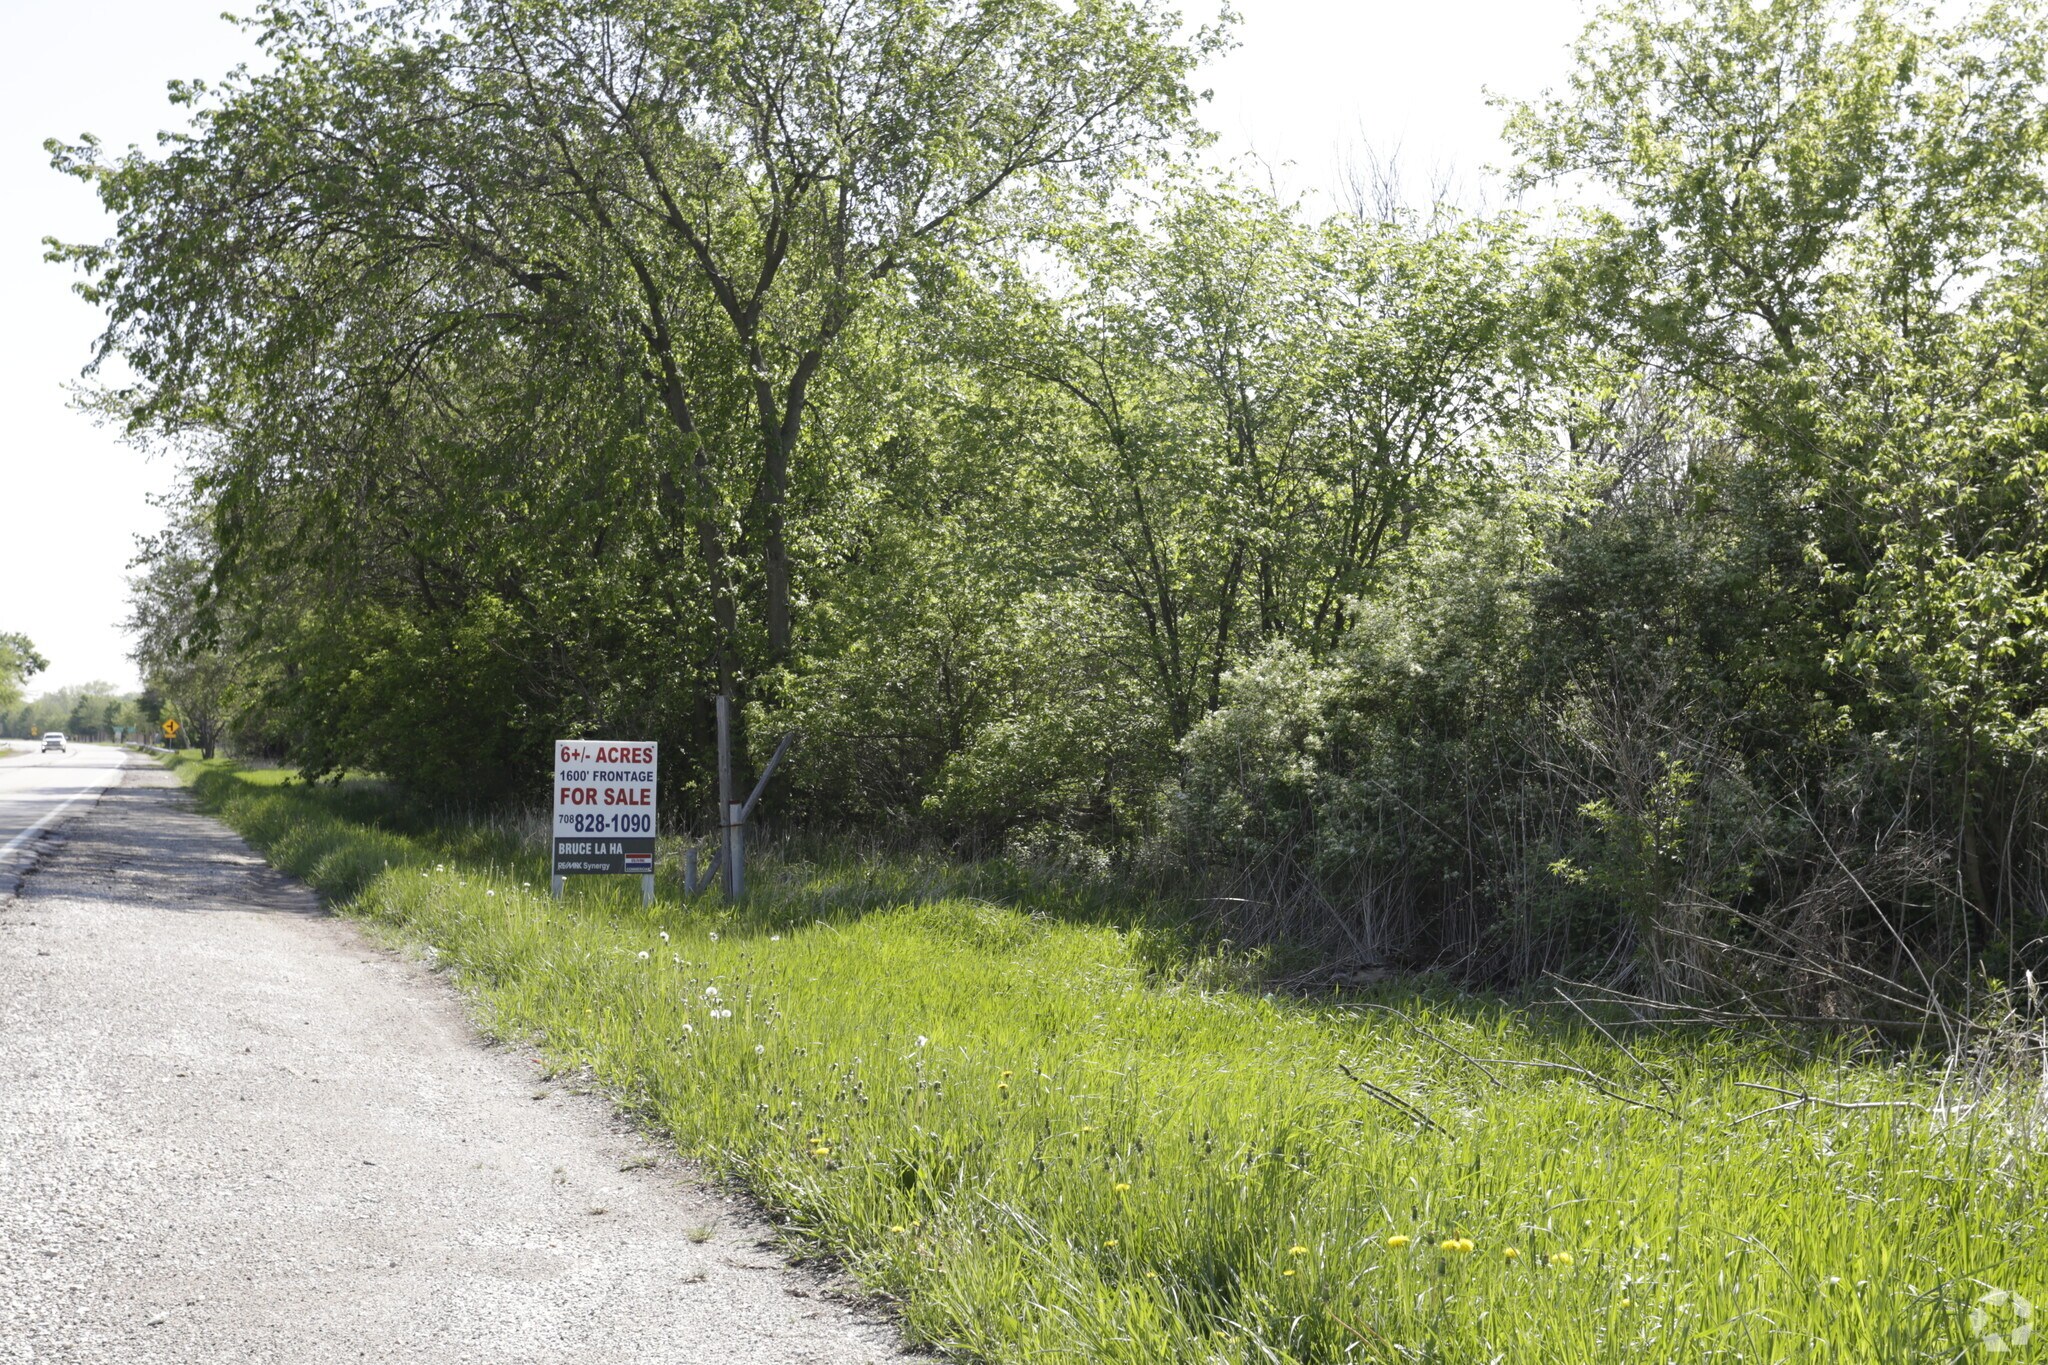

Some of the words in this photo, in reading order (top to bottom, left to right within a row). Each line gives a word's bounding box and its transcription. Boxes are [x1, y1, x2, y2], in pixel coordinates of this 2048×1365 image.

[561, 746, 590, 763] 6+/-
[595, 747, 653, 764] ACRES
[560, 770, 590, 781] 1600'
[593, 770, 653, 782] FRONTAGE
[560, 787, 598, 805] FOR
[604, 788, 651, 805] SALE
[559, 814, 574, 824] 708
[575, 813, 651, 832] 828-1090
[558, 843, 591, 854] BRUCE
[595, 843, 607, 854] LA
[609, 843, 623, 854] HA
[583, 862, 610, 871] Synergy
